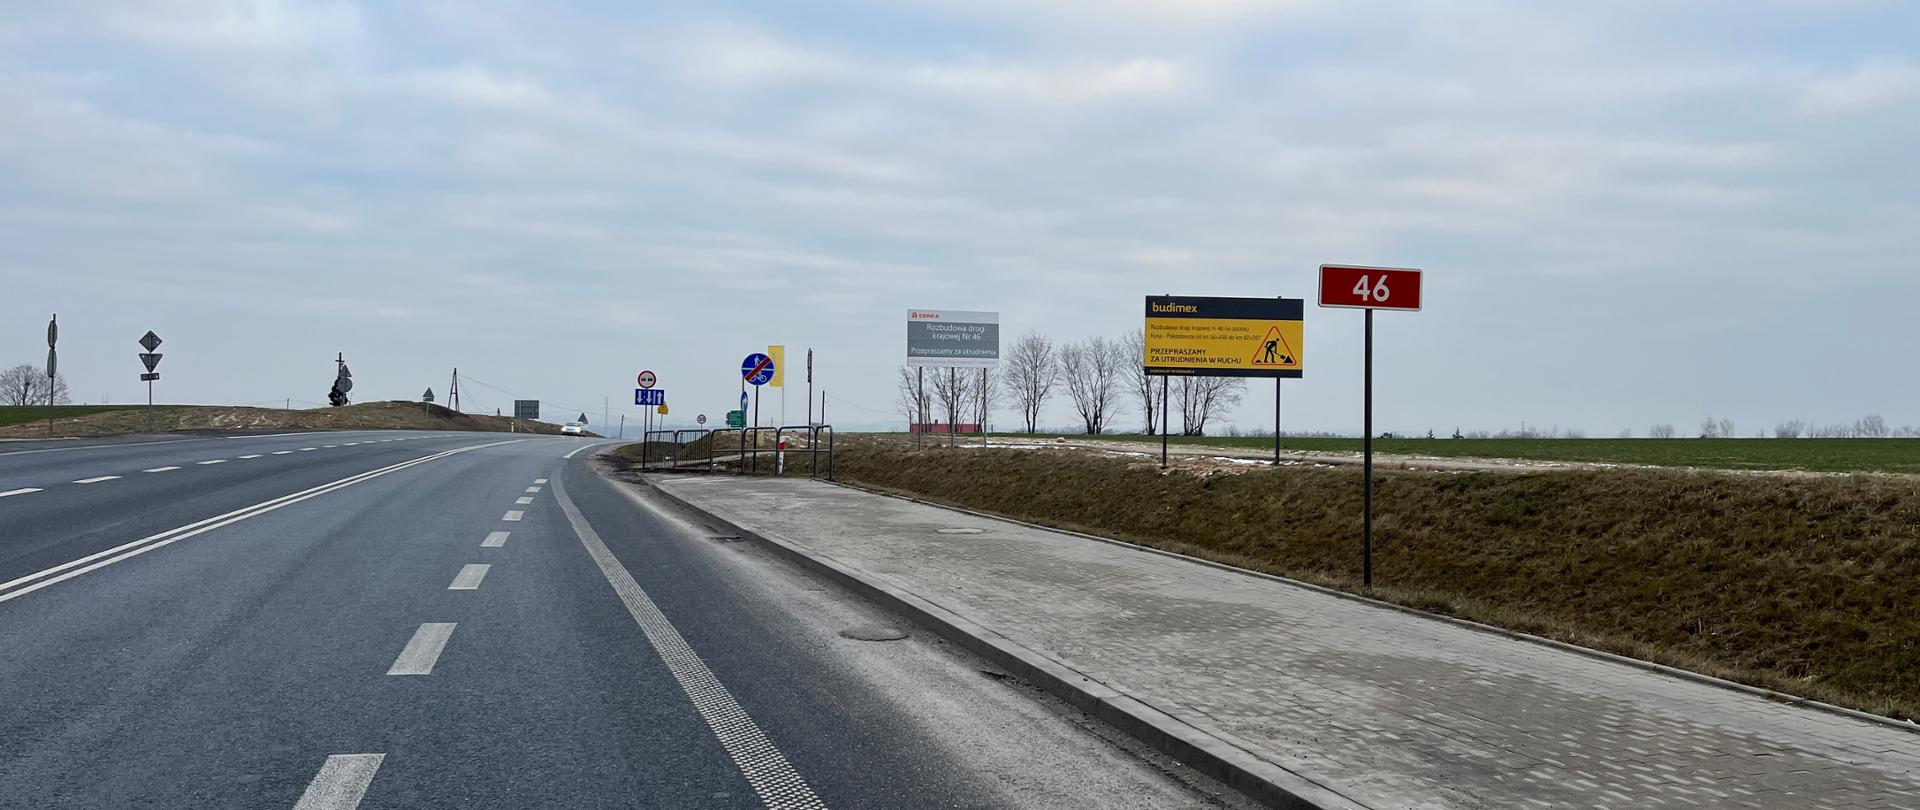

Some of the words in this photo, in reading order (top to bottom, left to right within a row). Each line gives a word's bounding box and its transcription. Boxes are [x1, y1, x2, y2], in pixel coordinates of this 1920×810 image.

[1352, 274, 1390, 302] 46
[1152, 301, 1198, 313] budimex
[926, 323, 967, 332] Rozbudowa
[968, 325, 987, 334] drogi
[932, 332, 961, 342] krajowej
[910, 346, 953, 356] Przepraszamy
[1150, 348, 1206, 356] PRZEPRASZAMY
[1162, 356, 1208, 364] UTRUDNIENIA
